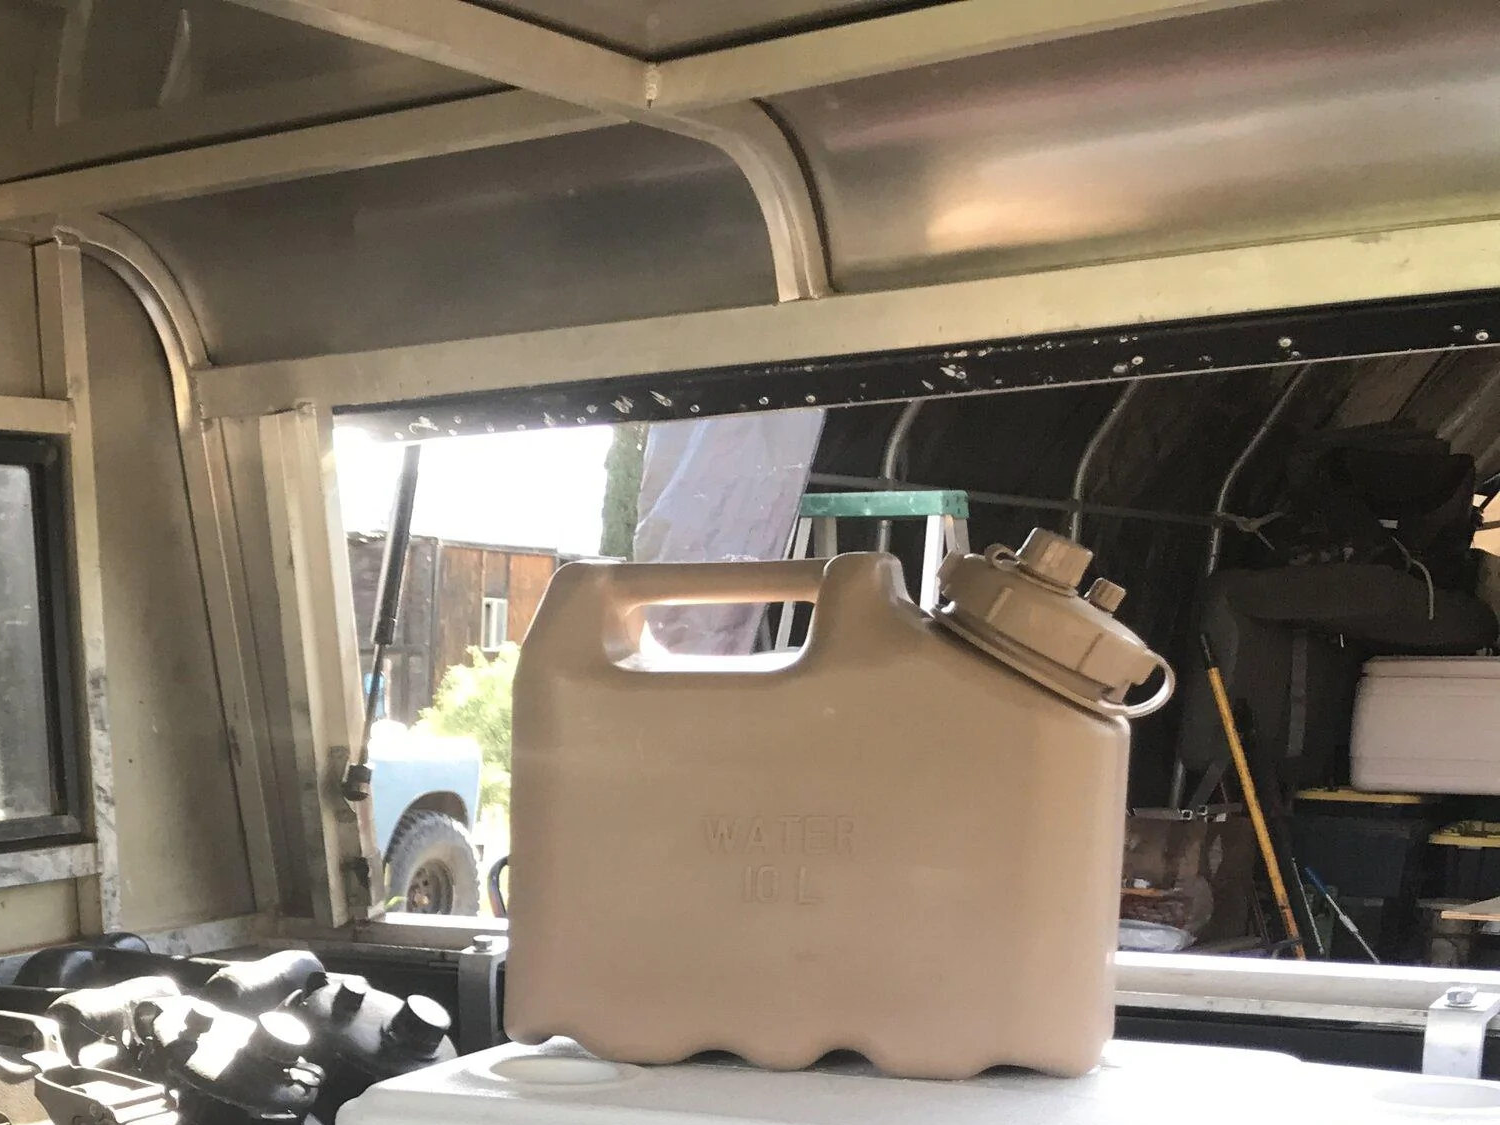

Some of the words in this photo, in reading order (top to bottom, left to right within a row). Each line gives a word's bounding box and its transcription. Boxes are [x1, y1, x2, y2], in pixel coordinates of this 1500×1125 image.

[701, 815, 857, 856] WATER
[742, 864, 781, 904] 10
[794, 865, 824, 905] L
